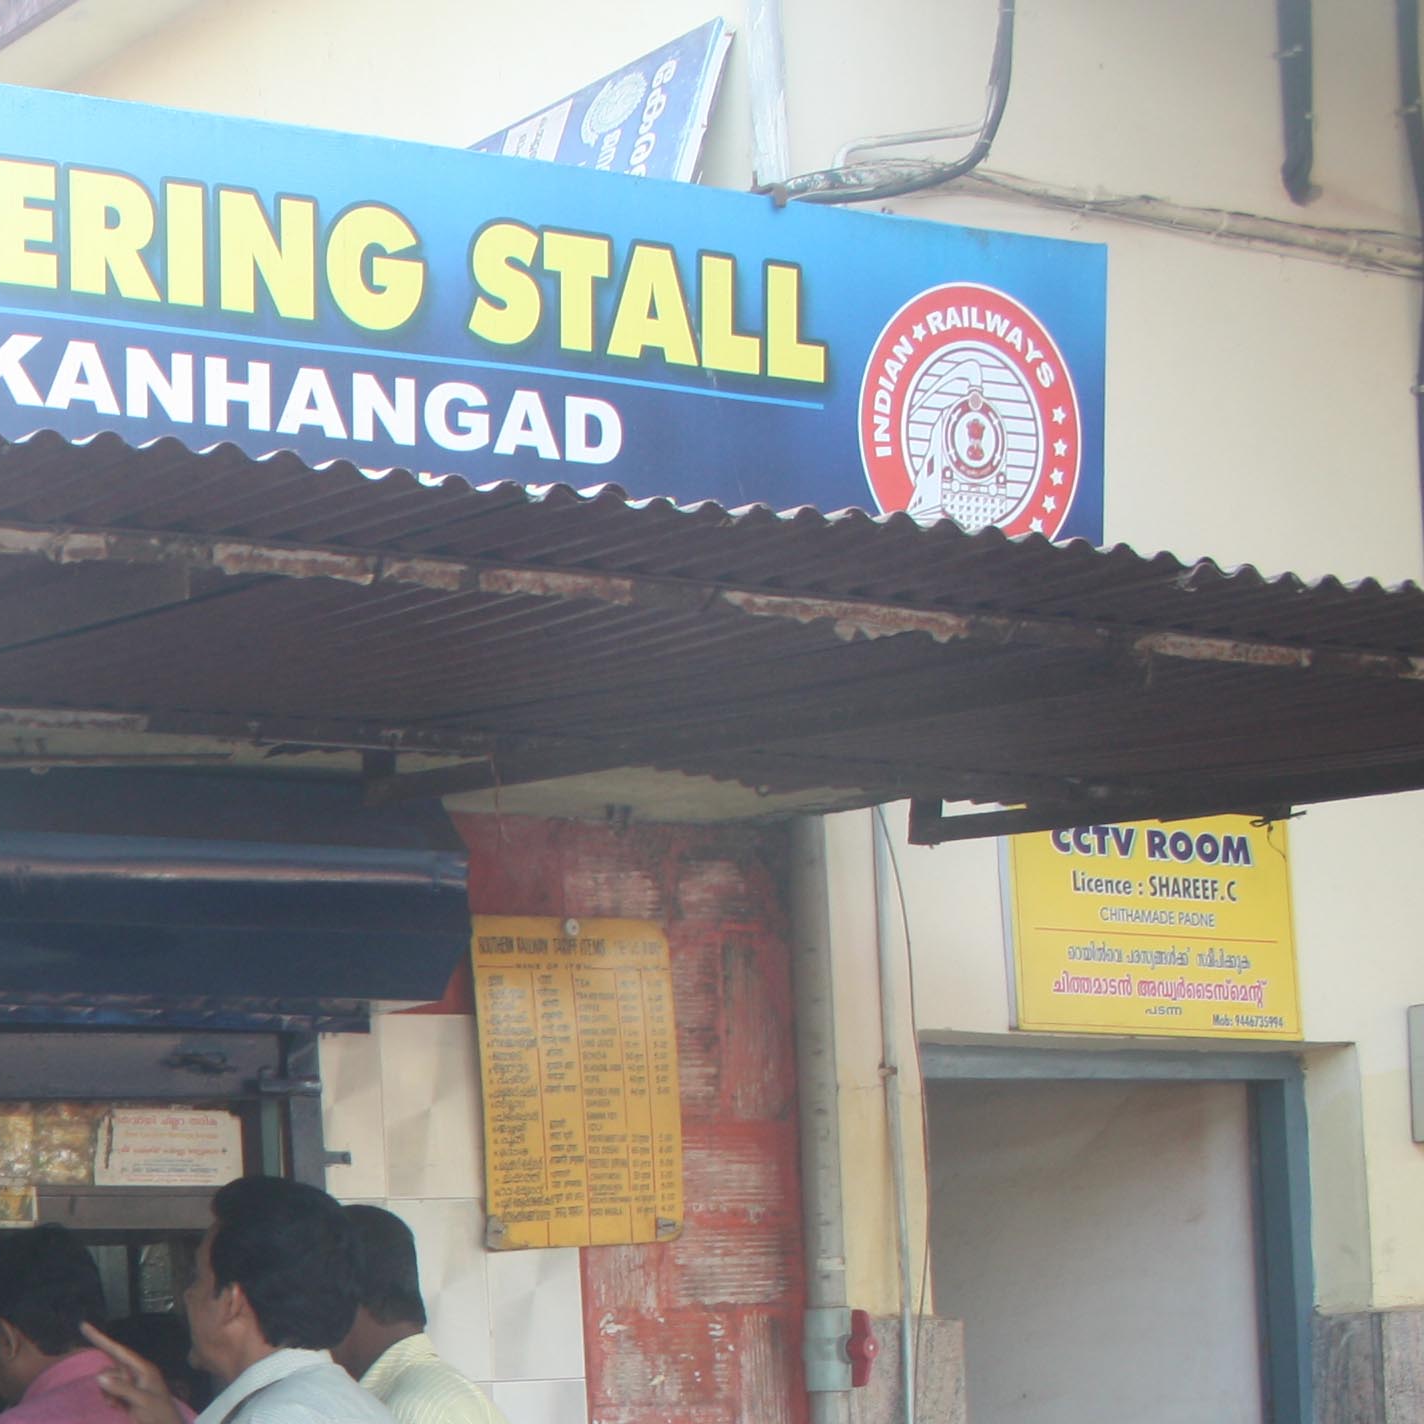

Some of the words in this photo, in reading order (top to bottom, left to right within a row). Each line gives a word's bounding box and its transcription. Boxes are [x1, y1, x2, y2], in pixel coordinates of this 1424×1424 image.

[467, 222, 827, 385] STALL
[873, 334, 915, 458] INDIAN
[925, 305, 1056, 389] RAILWAYS
[1051, 826, 1136, 857] CCTV
[1146, 829, 1252, 866] ROOM
[1072, 870, 1132, 896] Licence
[1149, 875, 1238, 902] SHAREEF.C
[1100, 907, 1175, 926] CHITHAMADE
